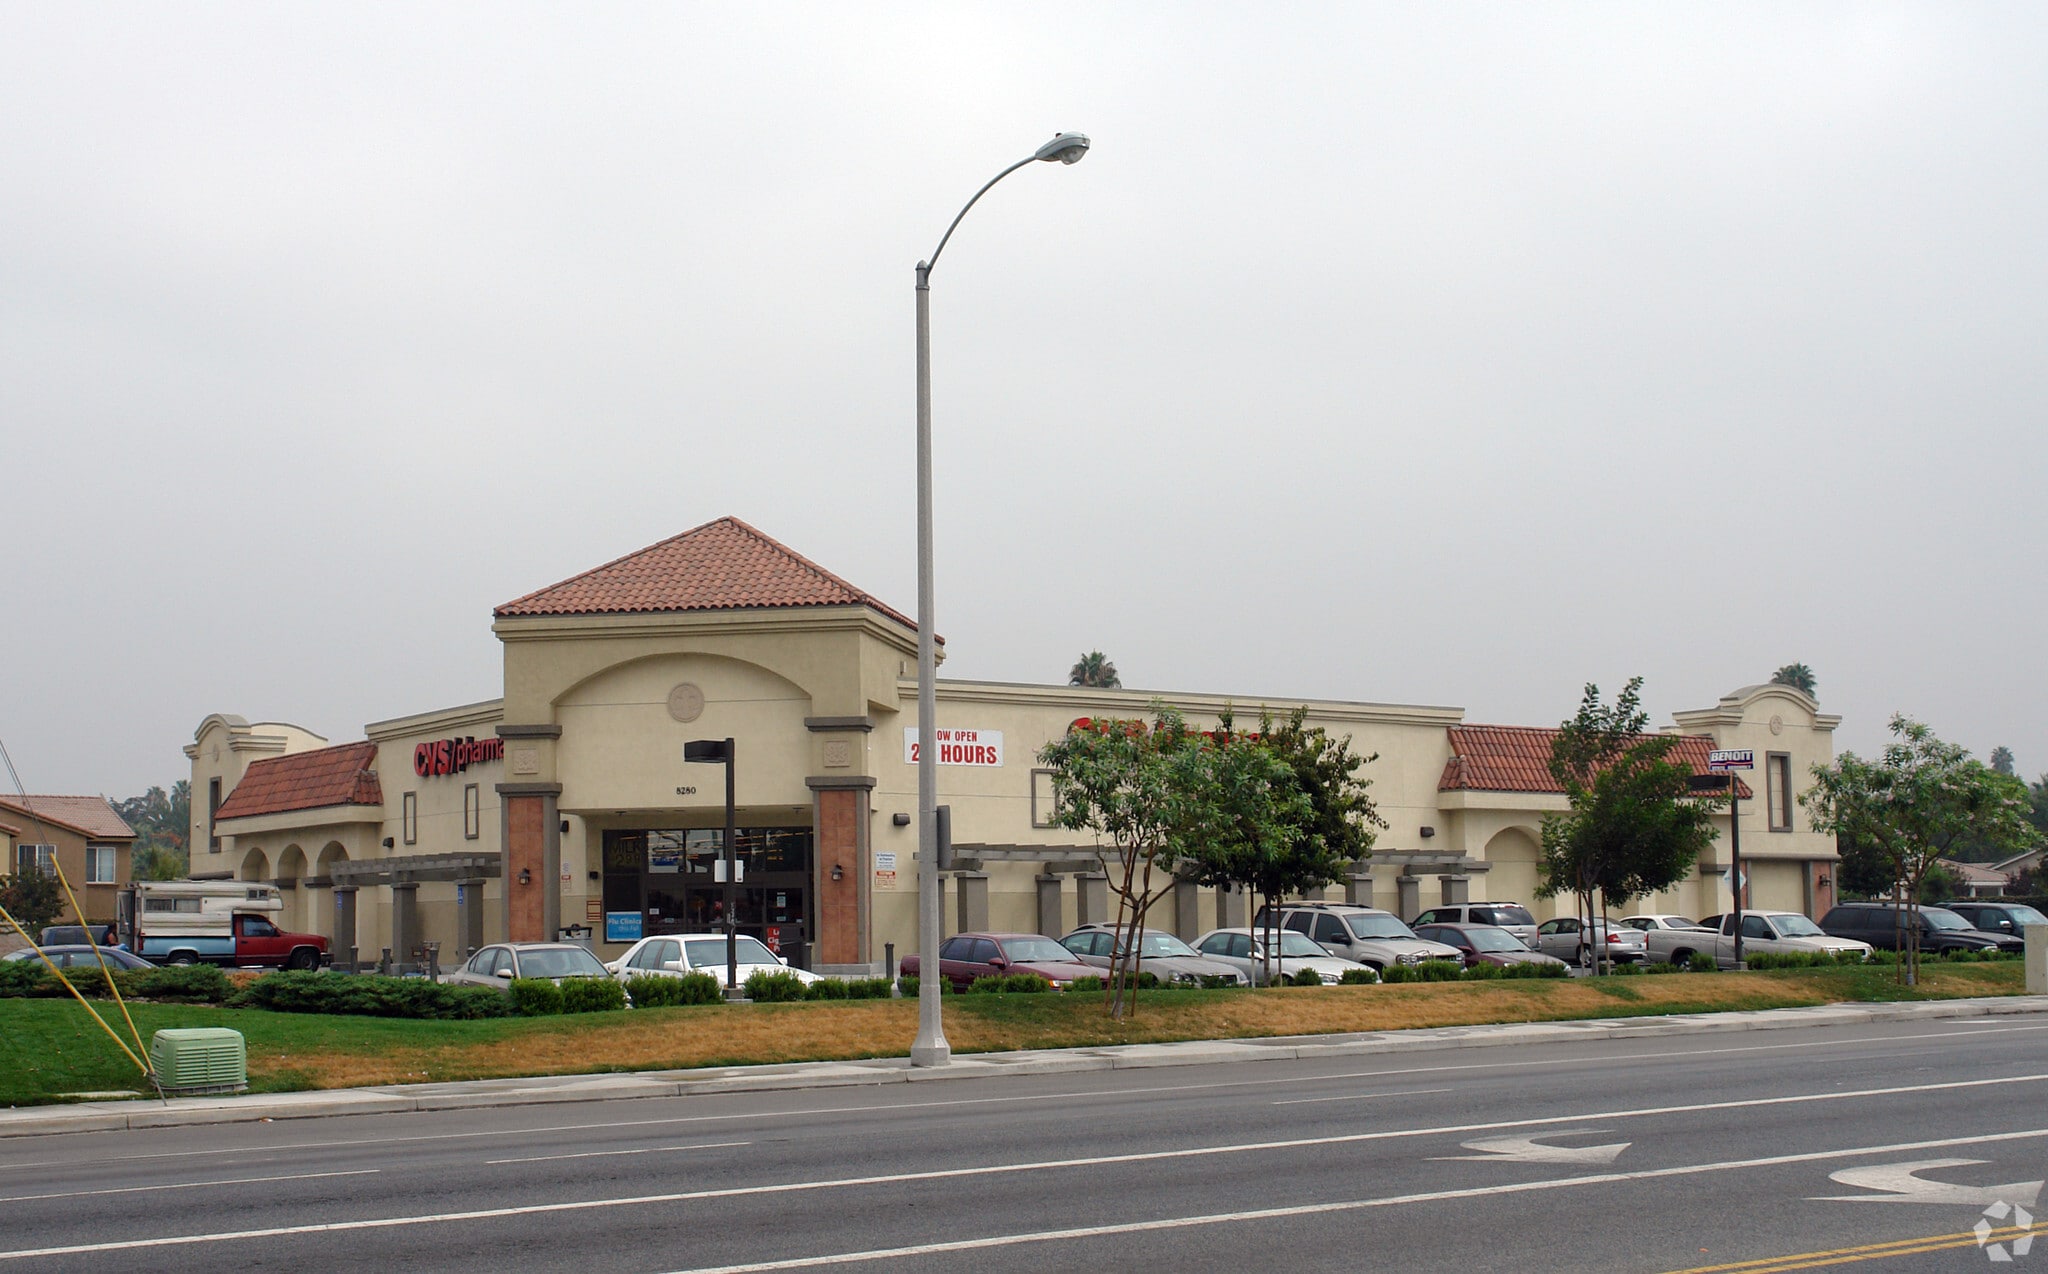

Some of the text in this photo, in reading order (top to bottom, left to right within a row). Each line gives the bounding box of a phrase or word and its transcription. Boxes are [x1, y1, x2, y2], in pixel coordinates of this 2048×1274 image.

[937, 730, 977, 742] OW OPEN
[414, 736, 505, 777] CVS/pharma
[941, 744, 997, 765] HOURS
[1711, 751, 1751, 762] BENOIT
[676, 786, 697, 795] 8280
